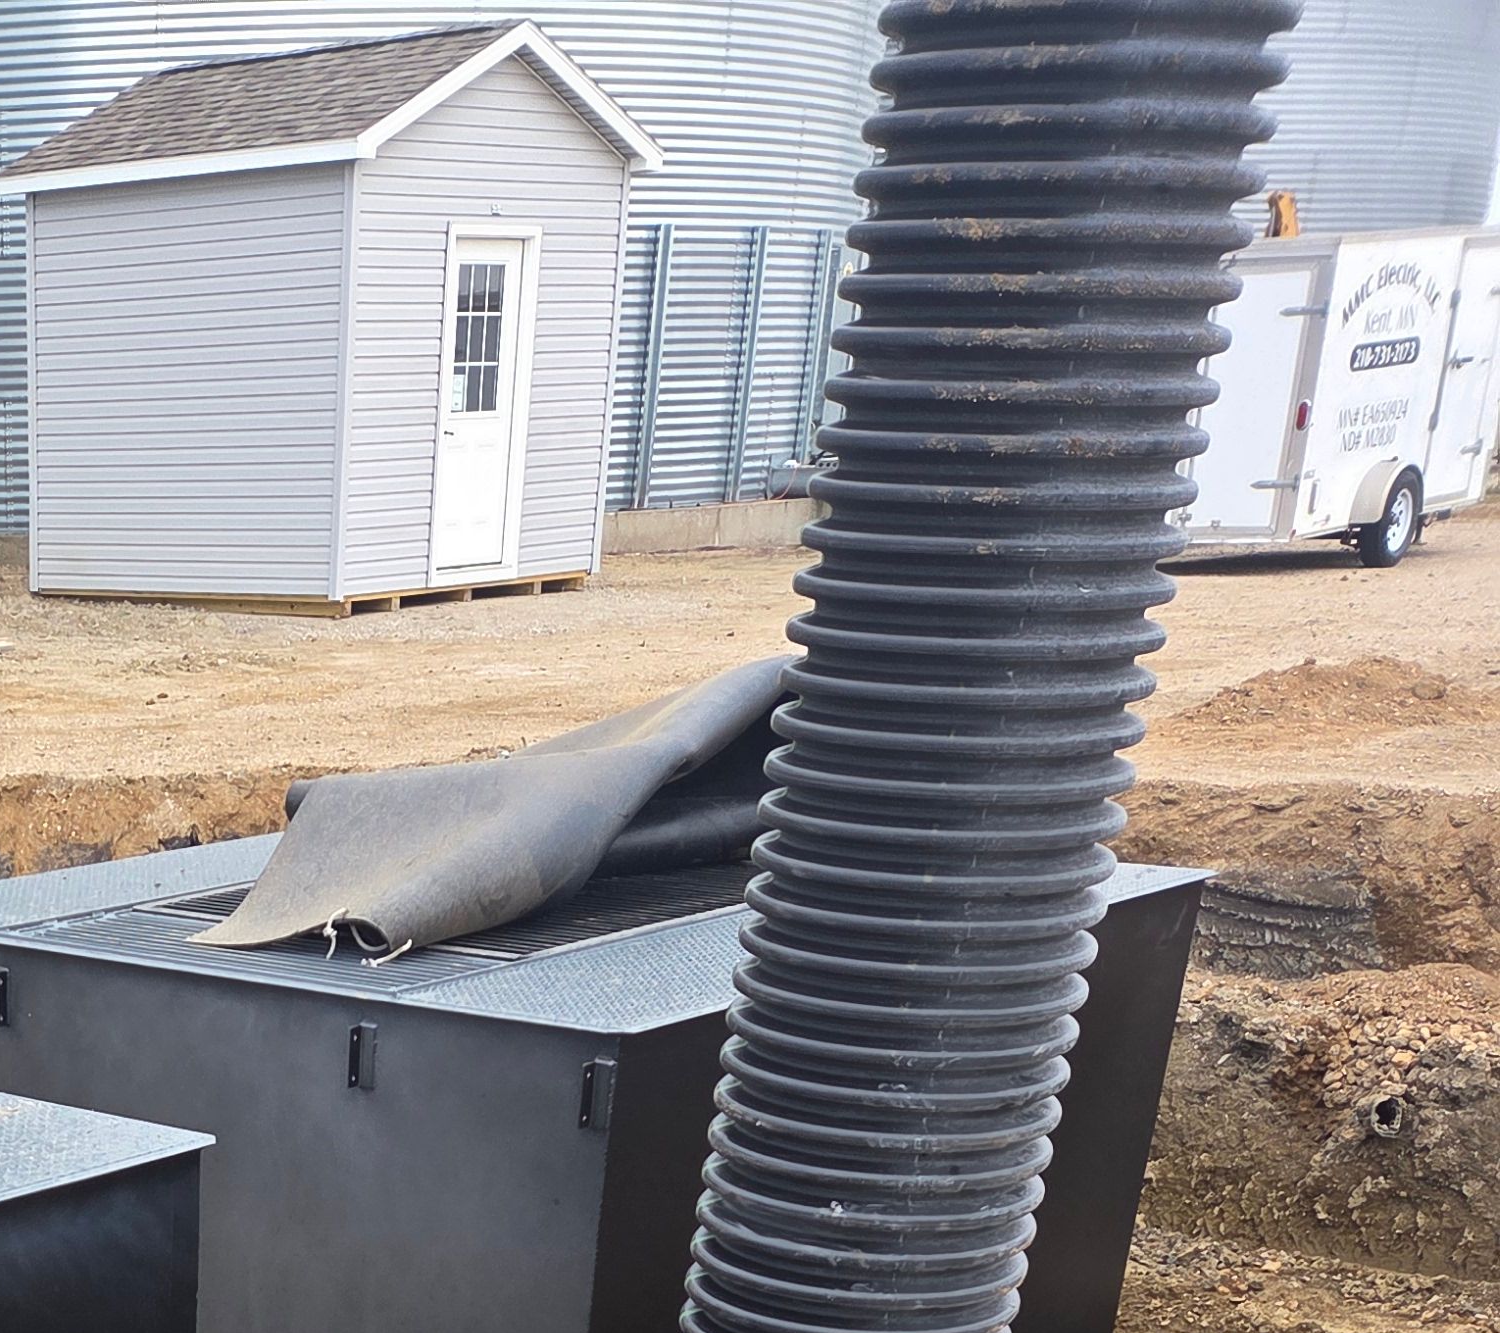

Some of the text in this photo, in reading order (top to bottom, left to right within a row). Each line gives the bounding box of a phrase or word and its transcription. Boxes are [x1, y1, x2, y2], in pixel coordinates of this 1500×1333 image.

[1342, 273, 1374, 329] MMC
[1364, 303, 1418, 334] Kent, MN
[1337, 406, 1360, 429] MN#
[1340, 430, 1362, 453] ND#
